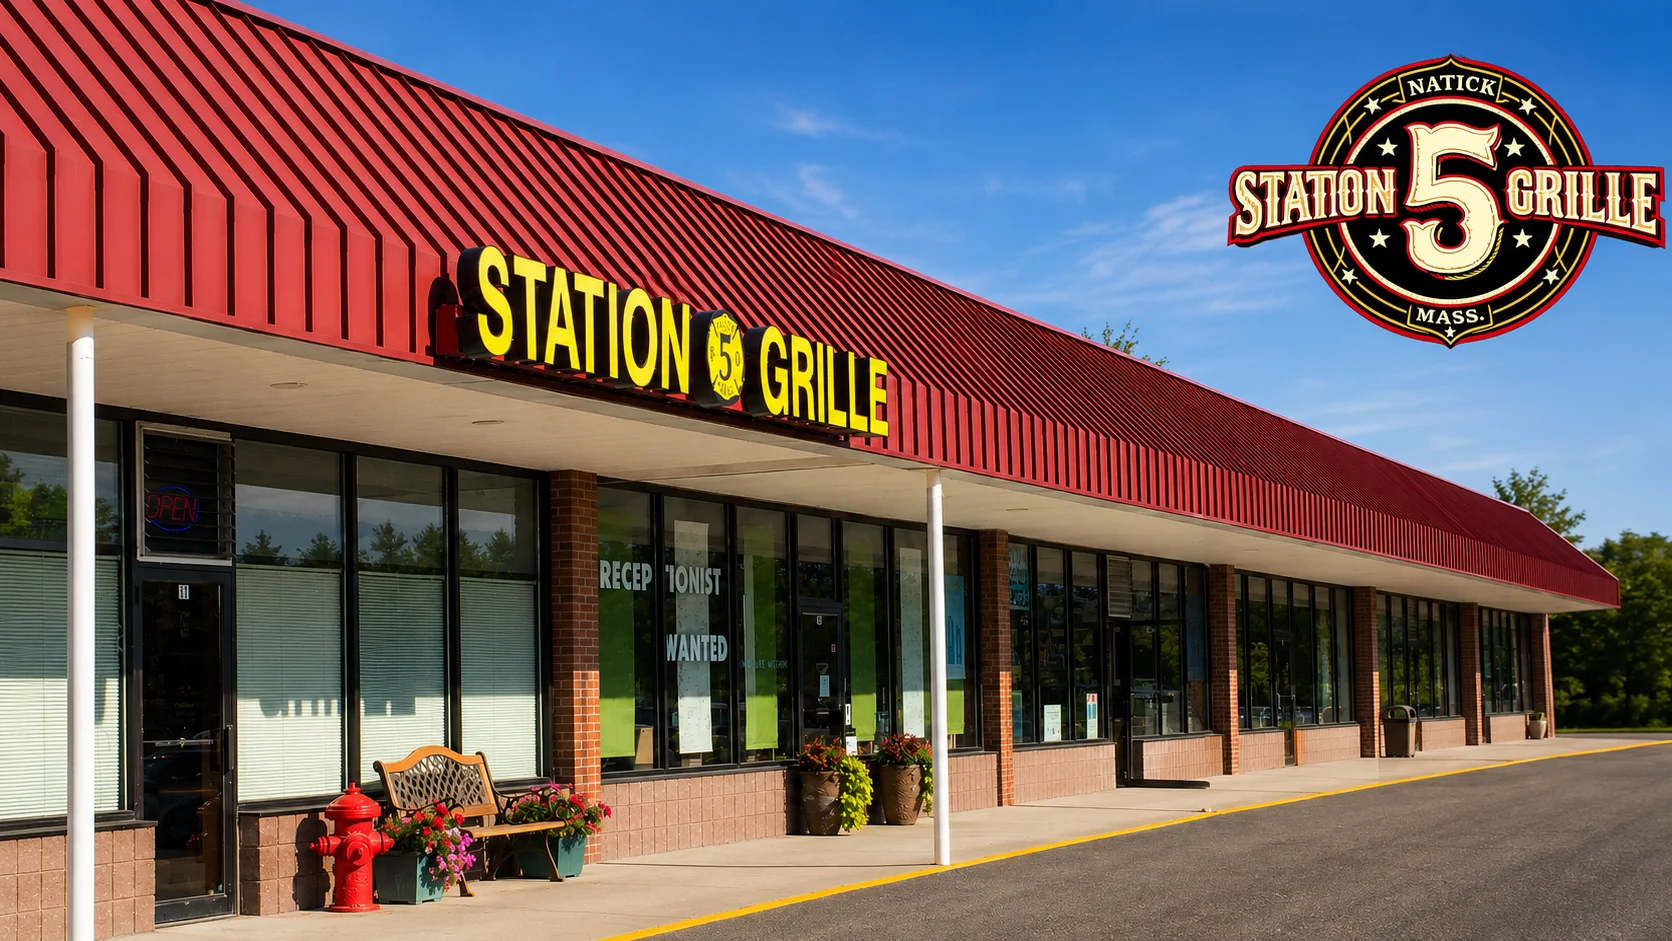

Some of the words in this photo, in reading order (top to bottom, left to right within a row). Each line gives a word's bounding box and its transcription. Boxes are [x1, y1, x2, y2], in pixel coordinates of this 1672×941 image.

[477, 245, 690, 394] STATION
[719, 332, 732, 381] 5
[760, 326, 888, 437] GRILLE
[146, 494, 196, 522] OPEN
[600, 560, 653, 591] RECEP
[666, 634, 728, 662] WANTED
